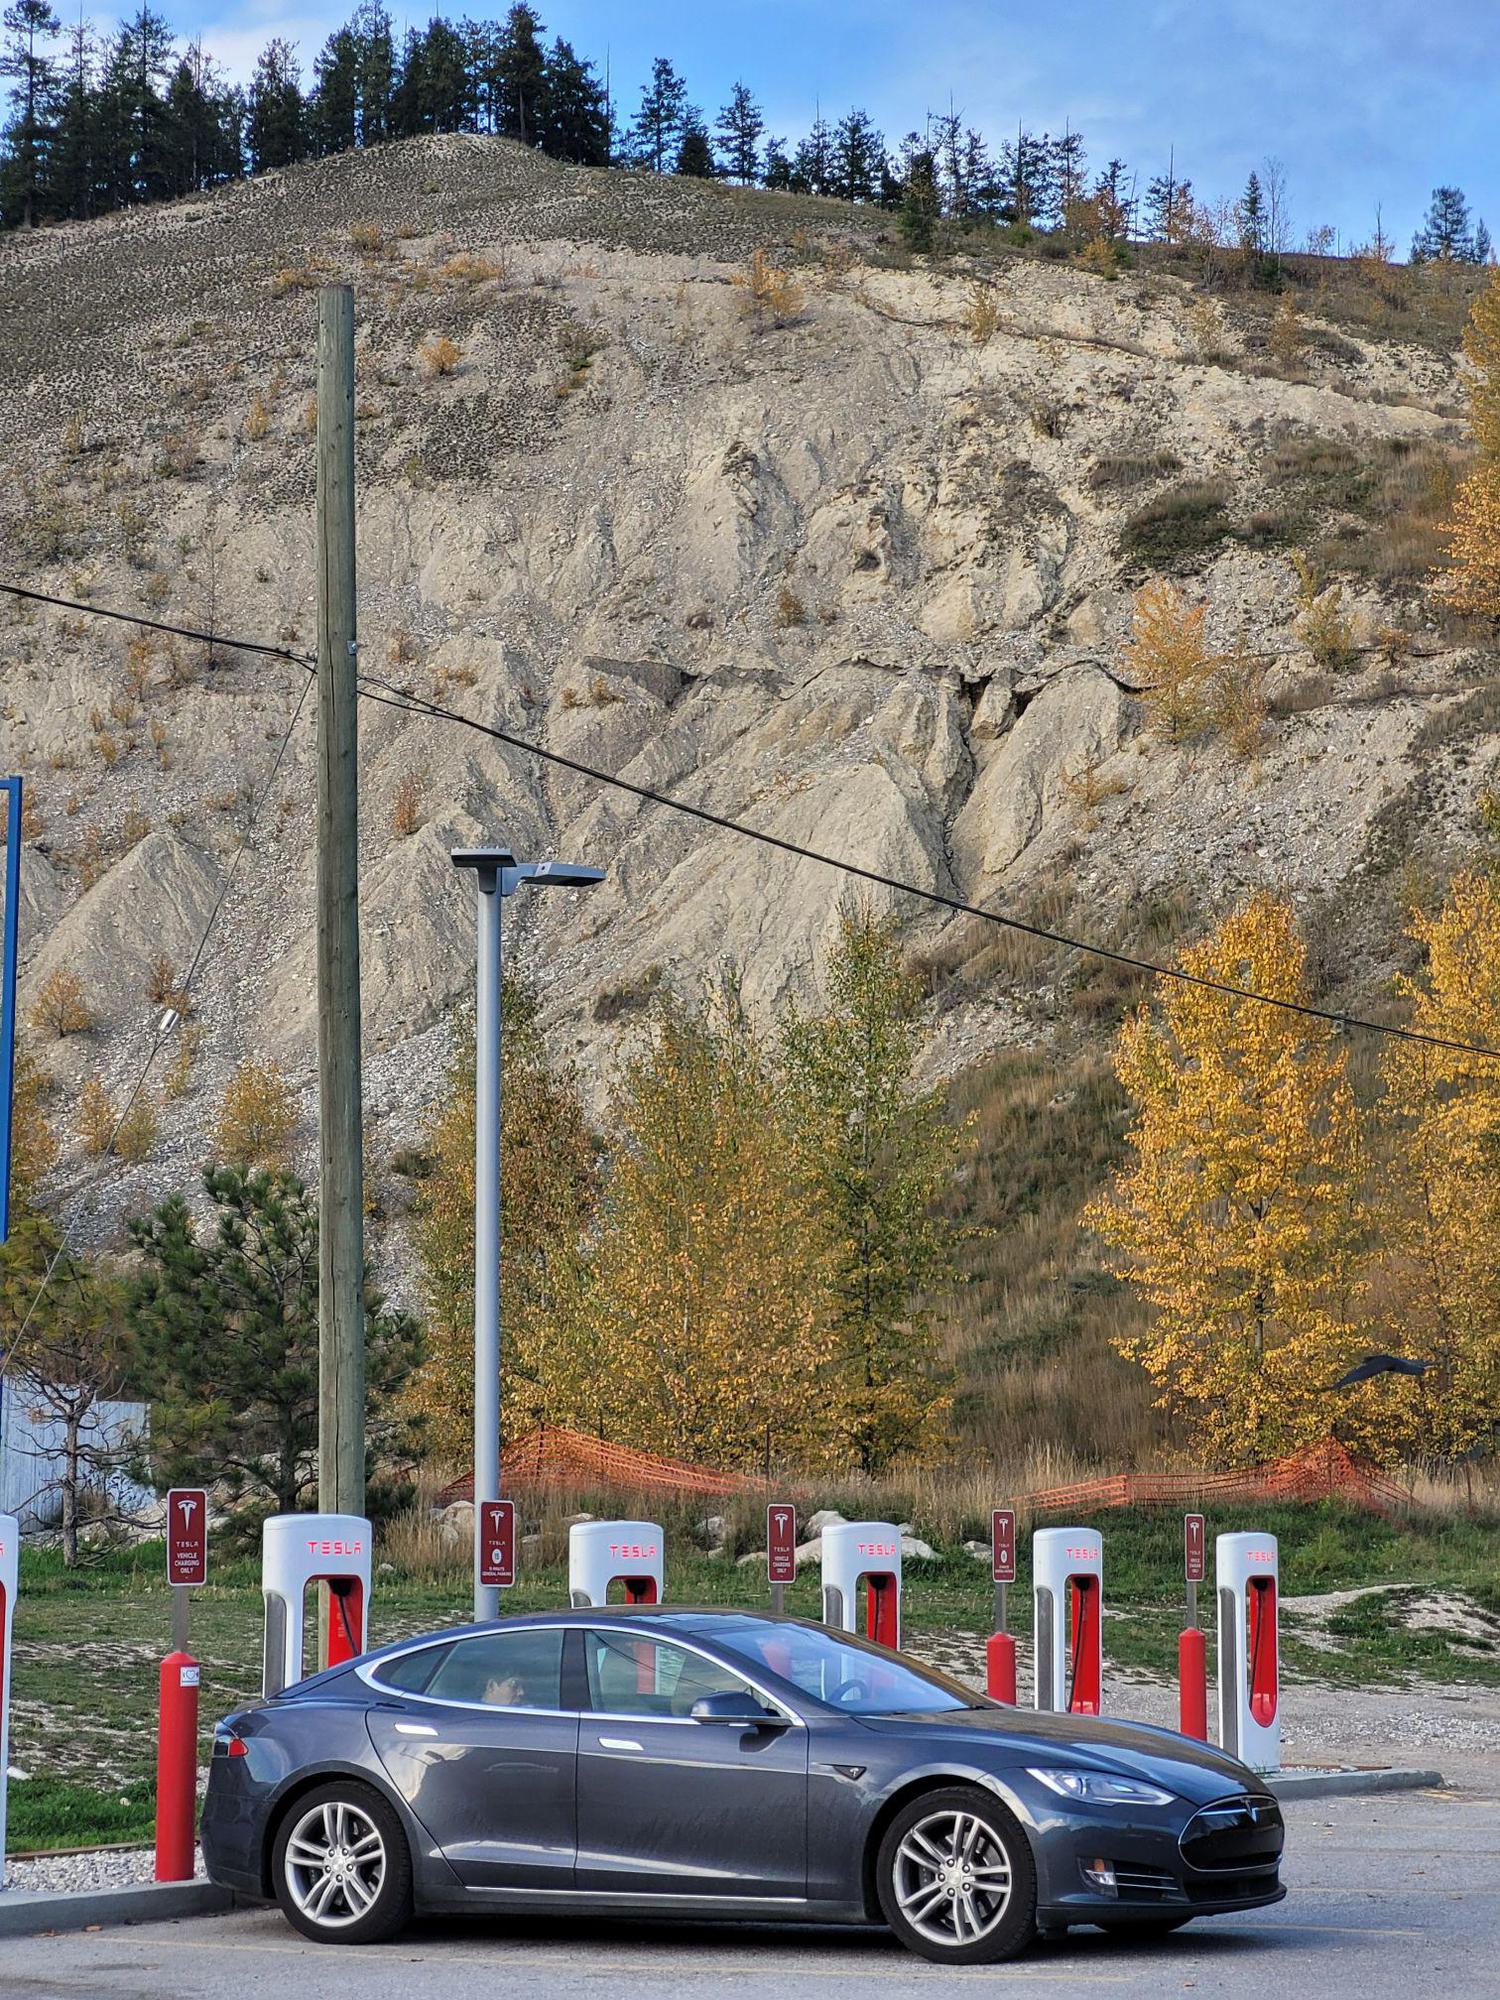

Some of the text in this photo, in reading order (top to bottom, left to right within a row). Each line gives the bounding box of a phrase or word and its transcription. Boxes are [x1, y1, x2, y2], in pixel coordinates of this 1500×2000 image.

[306, 1541, 362, 1555] TESLA
[609, 1545, 656, 1558] TESLA
[857, 1544, 897, 1556] TESLA
[1066, 1548, 1099, 1560] TESLA
[174, 1559, 200, 1567] CHARGING
